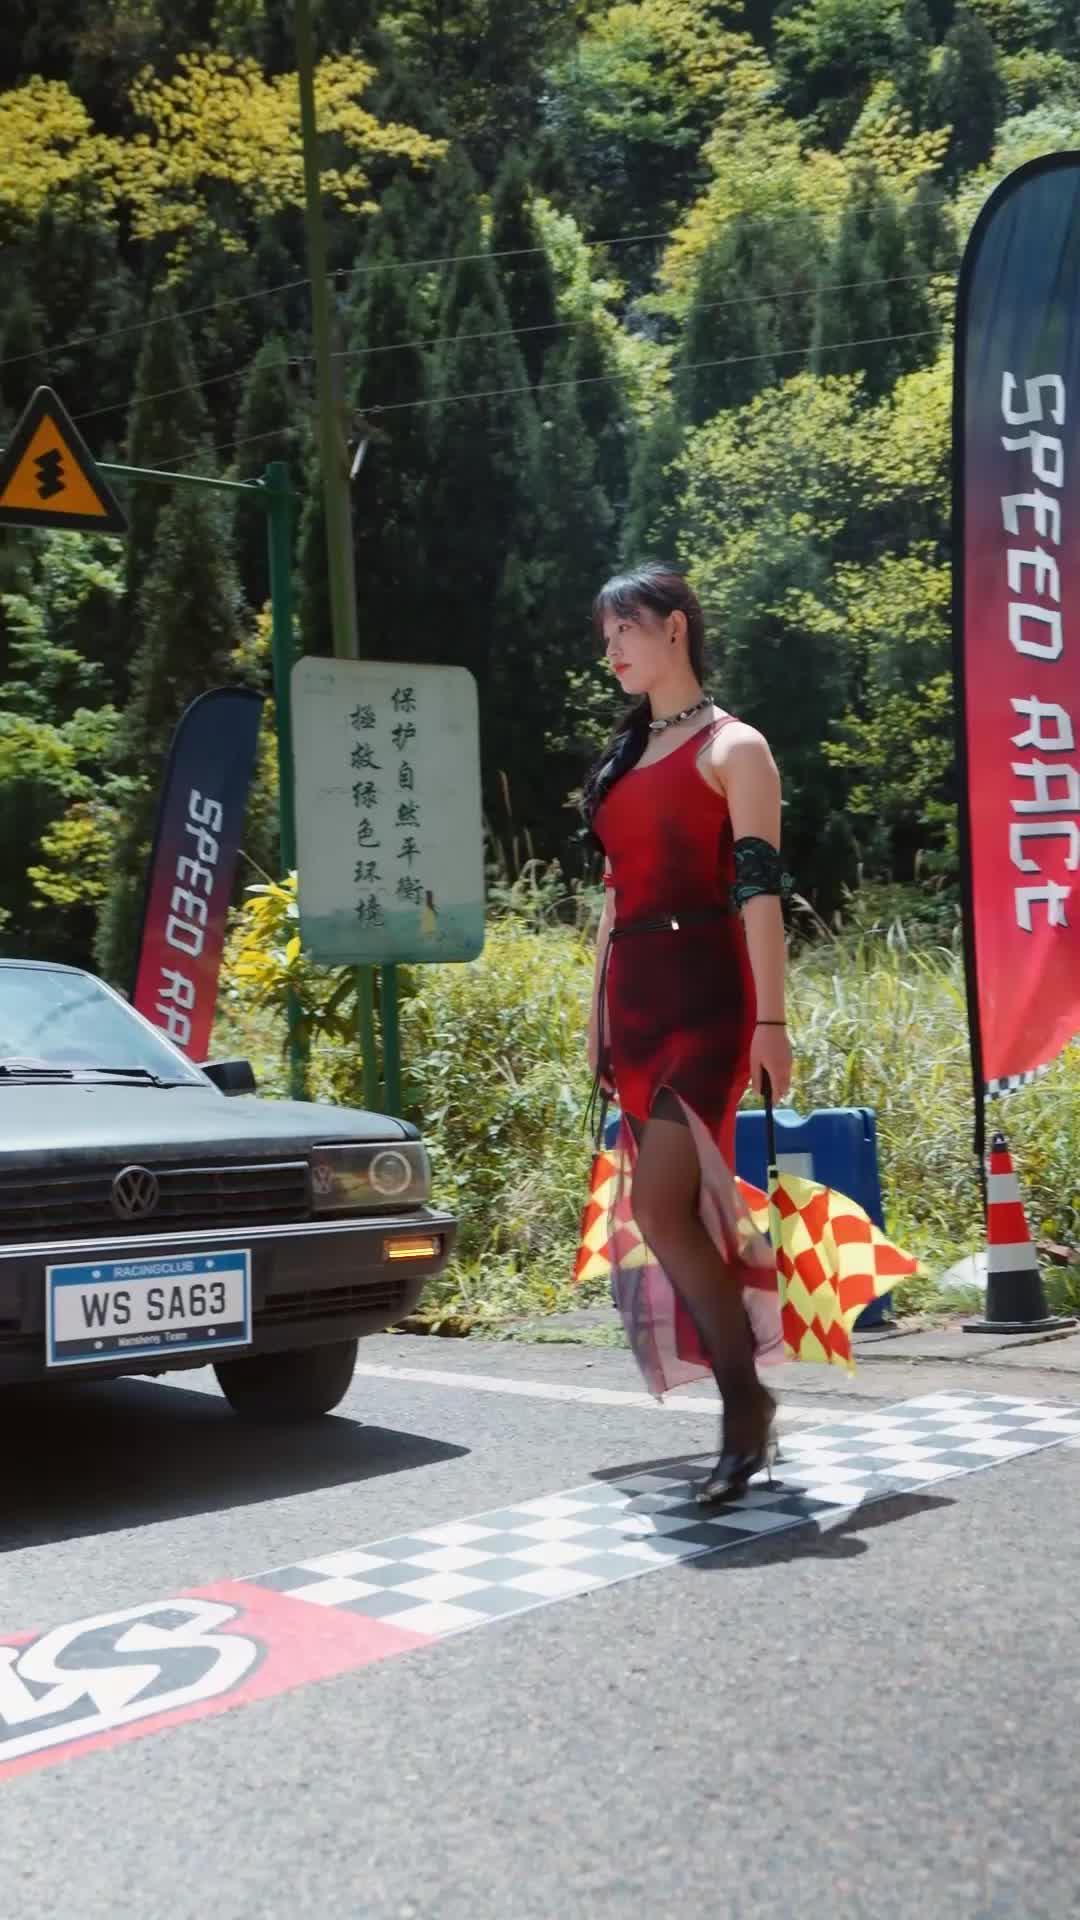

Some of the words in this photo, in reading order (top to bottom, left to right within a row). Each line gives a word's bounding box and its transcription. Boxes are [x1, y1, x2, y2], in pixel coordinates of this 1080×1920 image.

[1001, 371, 1066, 661] SPEED
[164, 788, 223, 958] SPEED
[349, 703, 385, 928] 拯救绿色环境
[391, 687, 424, 906] 保护自然平衡
[1007, 695, 1080, 932] RACE
[112, 1165, 159, 1219] VW
[81, 1290, 132, 1329] WS
[146, 1282, 226, 1321] SA63
